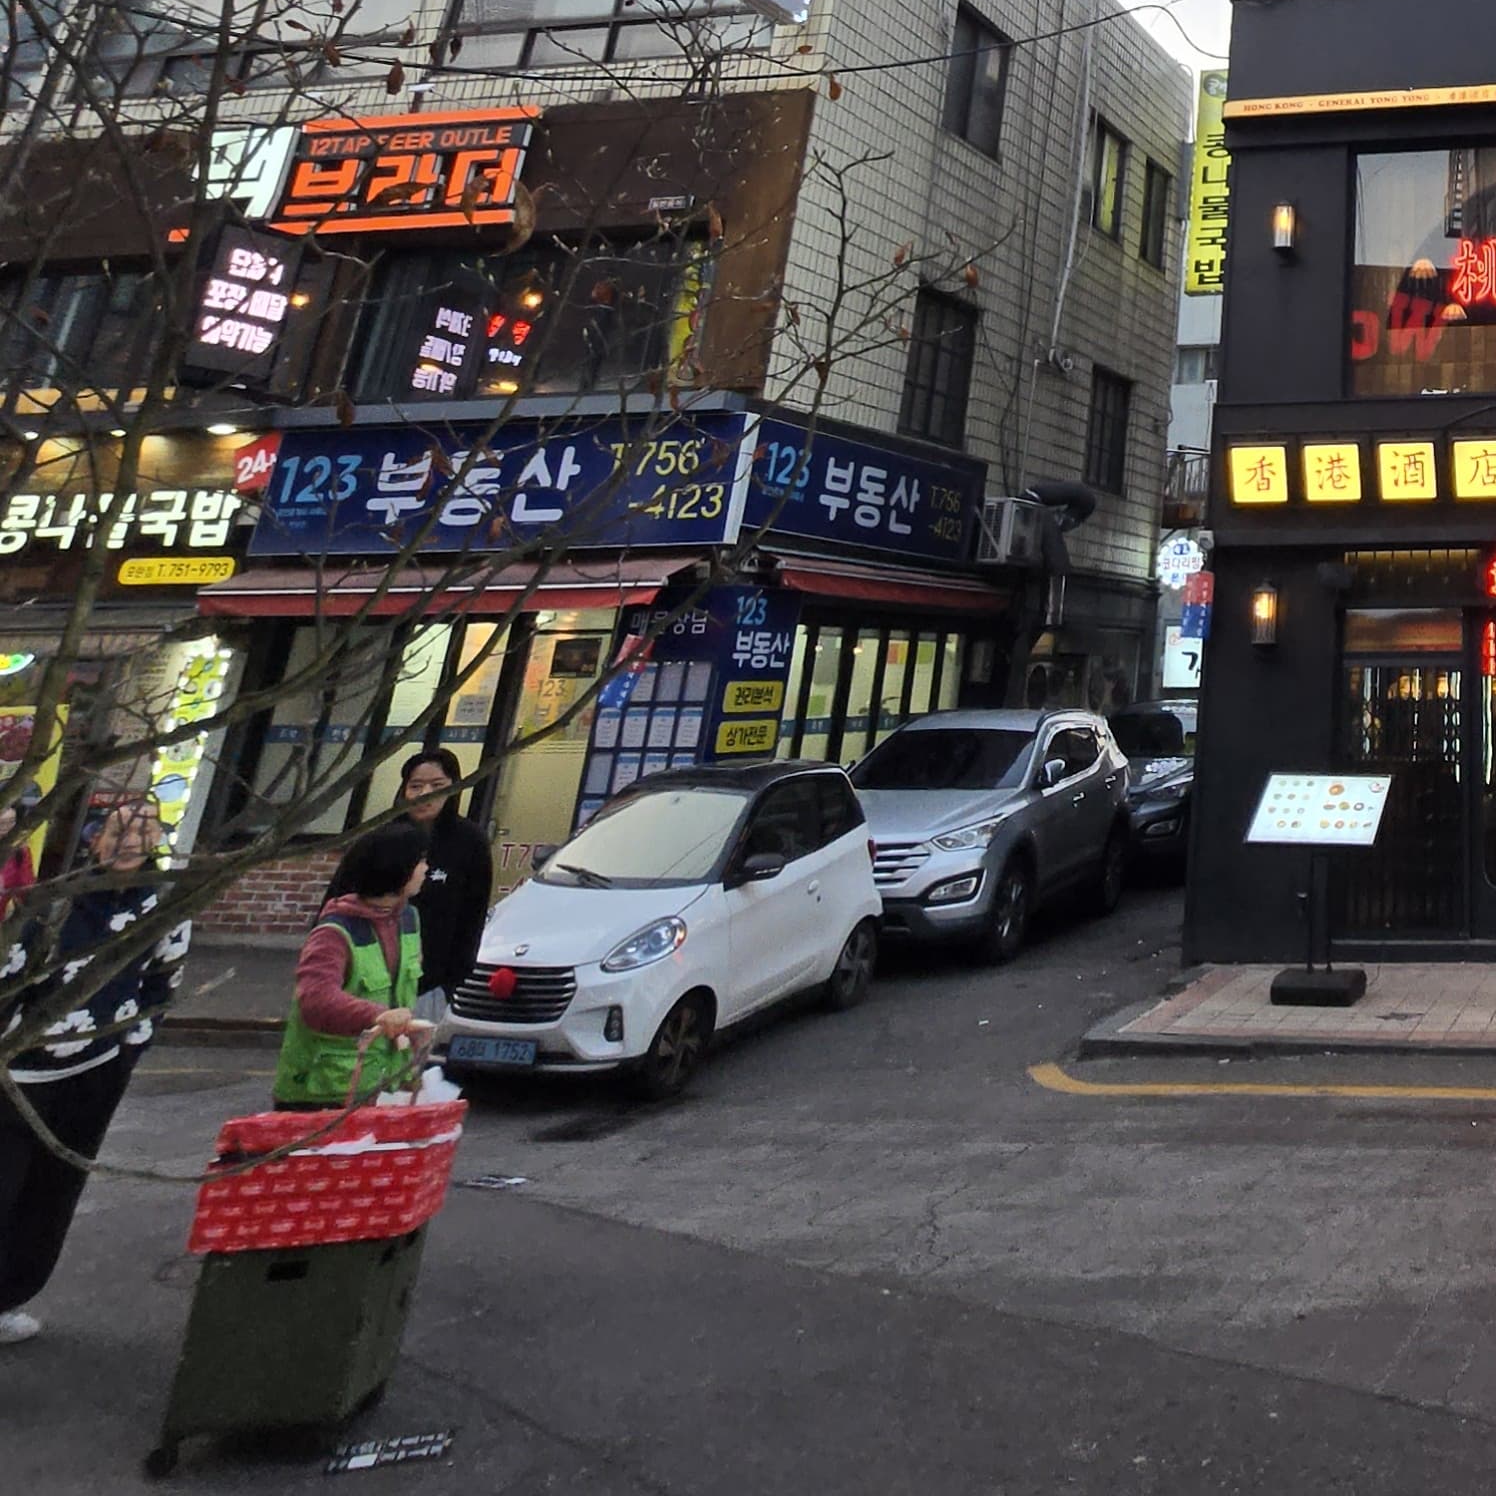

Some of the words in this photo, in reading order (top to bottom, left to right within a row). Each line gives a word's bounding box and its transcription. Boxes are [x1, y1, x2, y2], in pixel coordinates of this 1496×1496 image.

[279, 454, 363, 504] 123
[366, 445, 581, 526] 부동산
[766, 441, 813, 488] 123
[818, 456, 921, 535] 부동산
[156, 562, 229, 578] T.751-9793
[735, 595, 768, 625] 123
[731, 630, 790, 669] 부동산
[537, 679, 567, 698] 123
[734, 685, 775, 706] 권리분석
[726, 725, 768, 747] 상가전문
